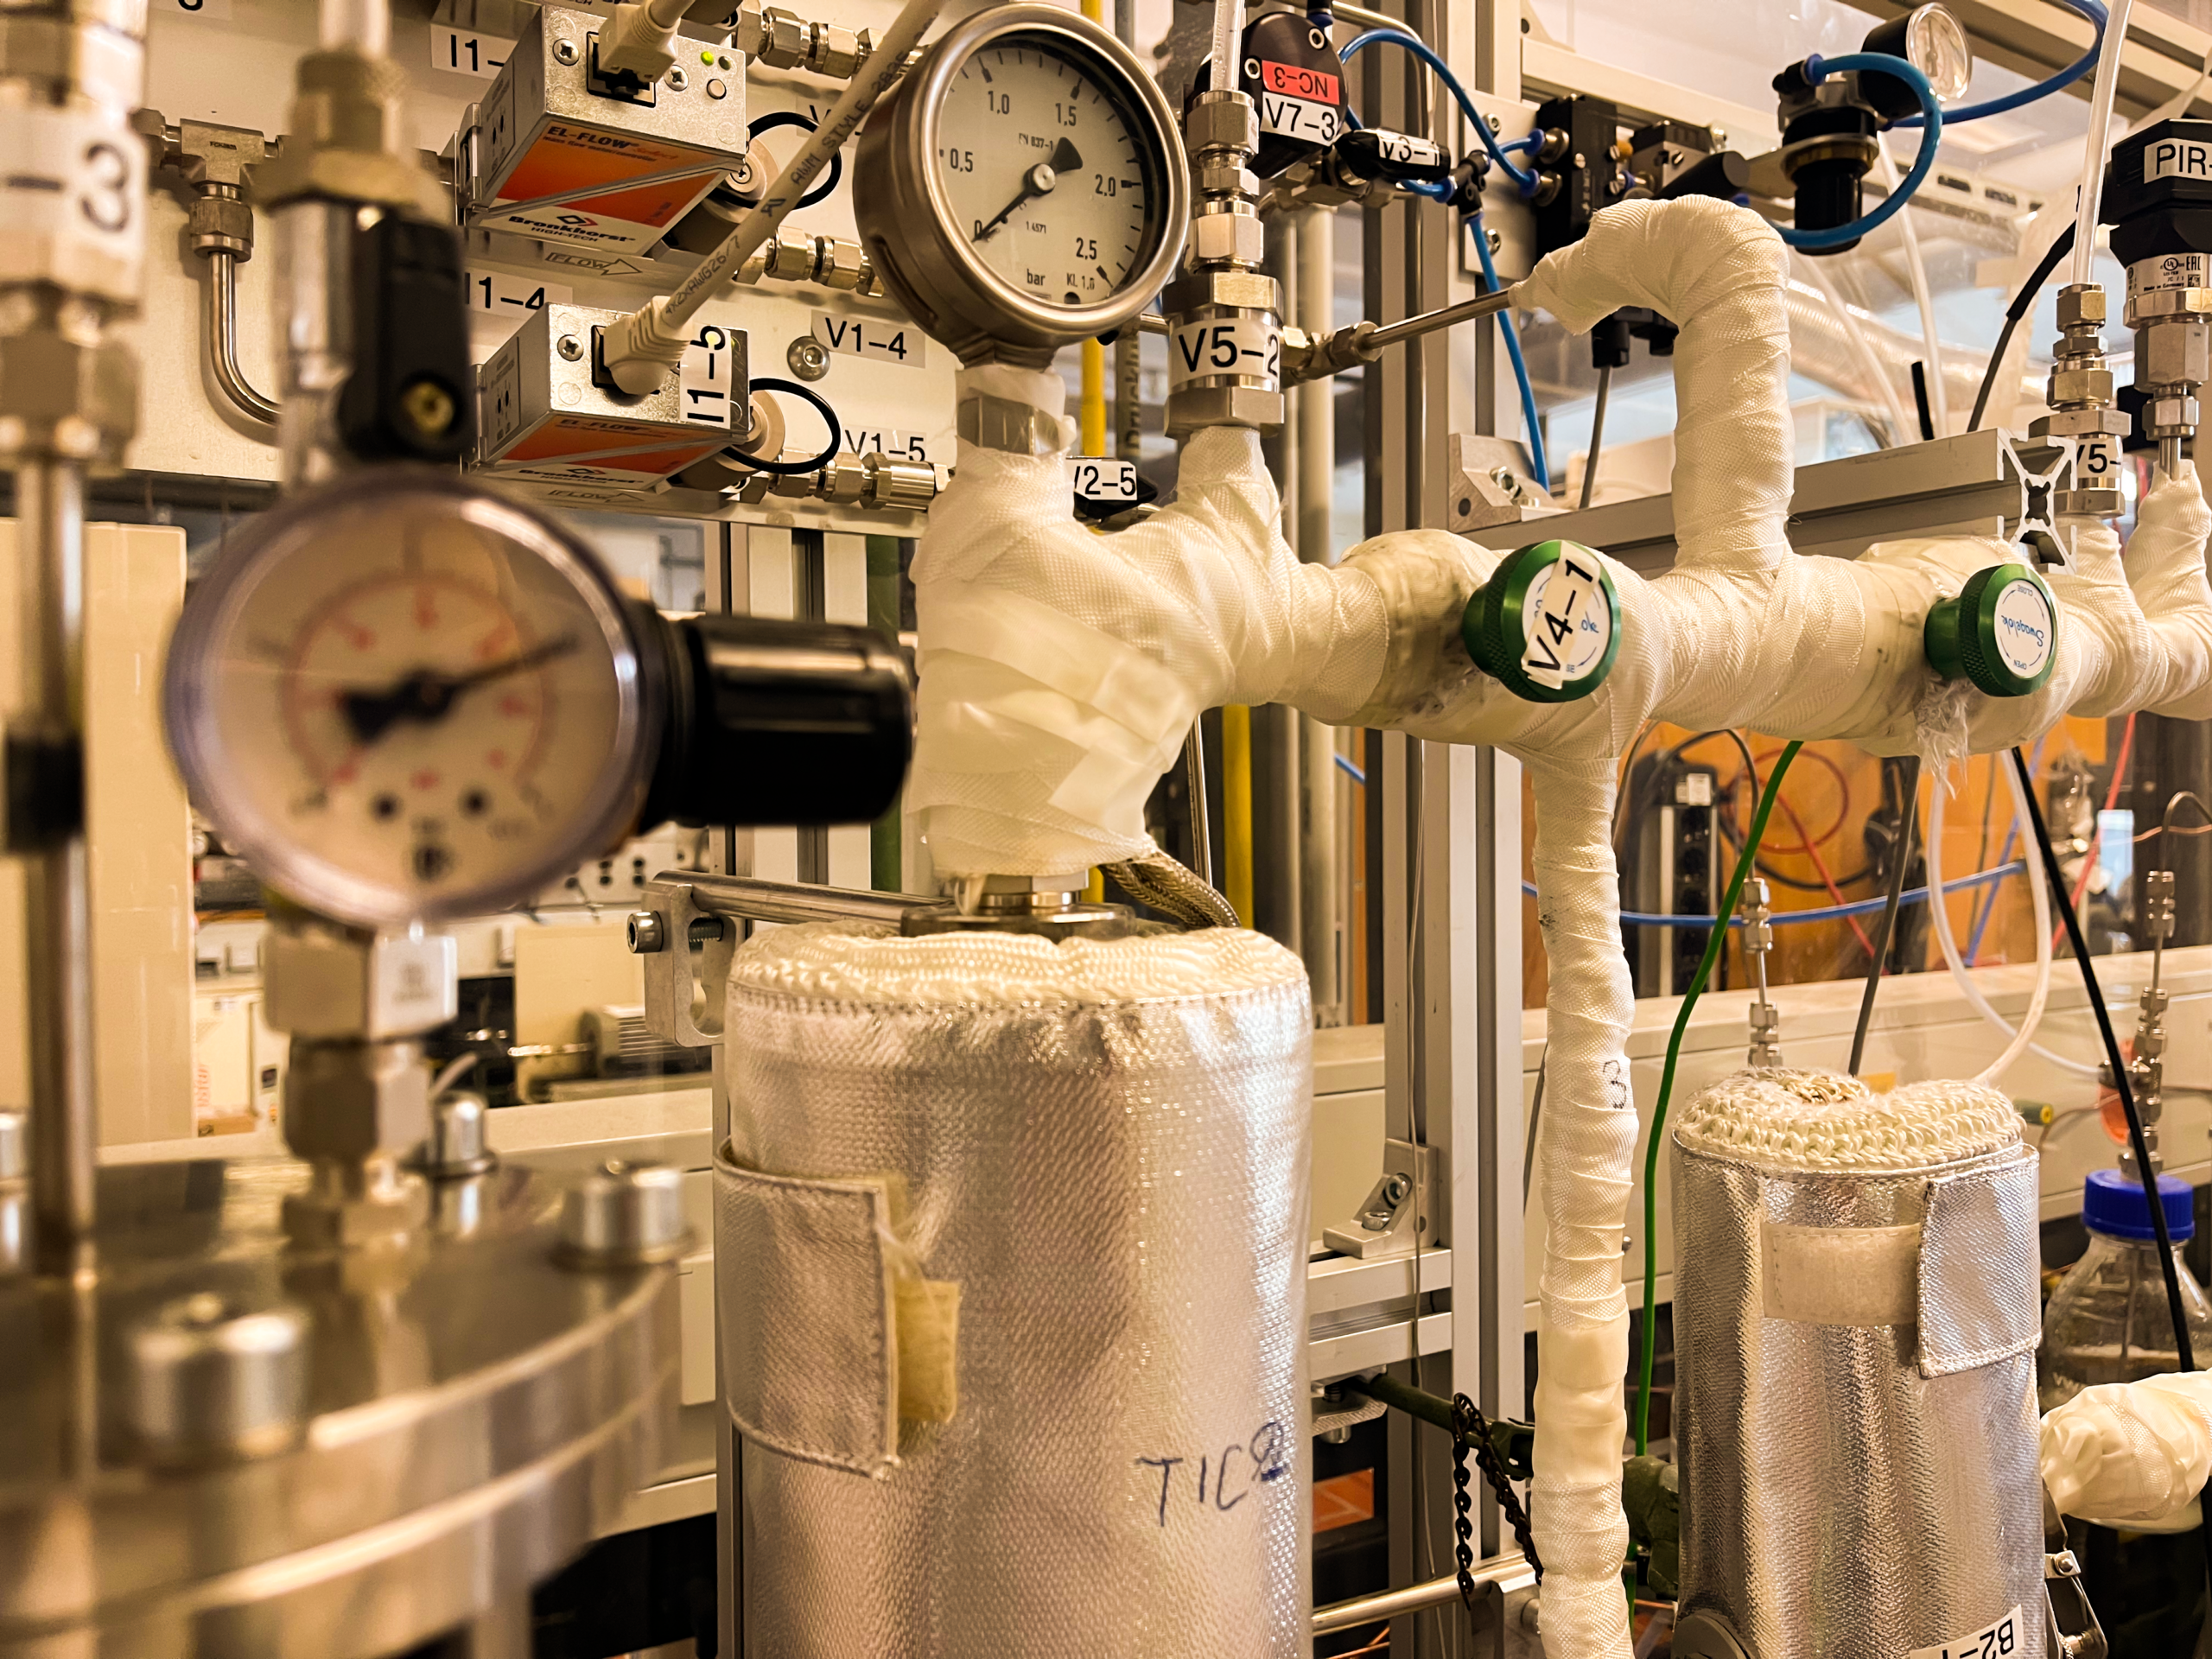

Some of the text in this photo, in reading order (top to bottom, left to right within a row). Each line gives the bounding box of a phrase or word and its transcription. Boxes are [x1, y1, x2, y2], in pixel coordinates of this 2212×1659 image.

[1274, 67, 1328, 98] NC-3
[822, 99, 869, 149] STYLE
[1264, 98, 1335, 142] V7-3
[2156, 143, 2212, 175] PIR
[508, 215, 629, 242] Bronkhorst
[531, 226, 598, 242] HIGH-TECH
[1027, 268, 1046, 286] bar
[825, 316, 907, 360] V1-4
[1178, 326, 1279, 378] V5-2
[687, 325, 725, 423] I1-5
[844, 429, 926, 462] V1-5
[2018, 584, 2033, 597] CLOSE
[1527, 558, 1593, 671] V4-1
[2000, 614, 2044, 647] Swagelok
[2013, 659, 2027, 670] OPEN
[1942, 1618, 2014, 1659] B2-
